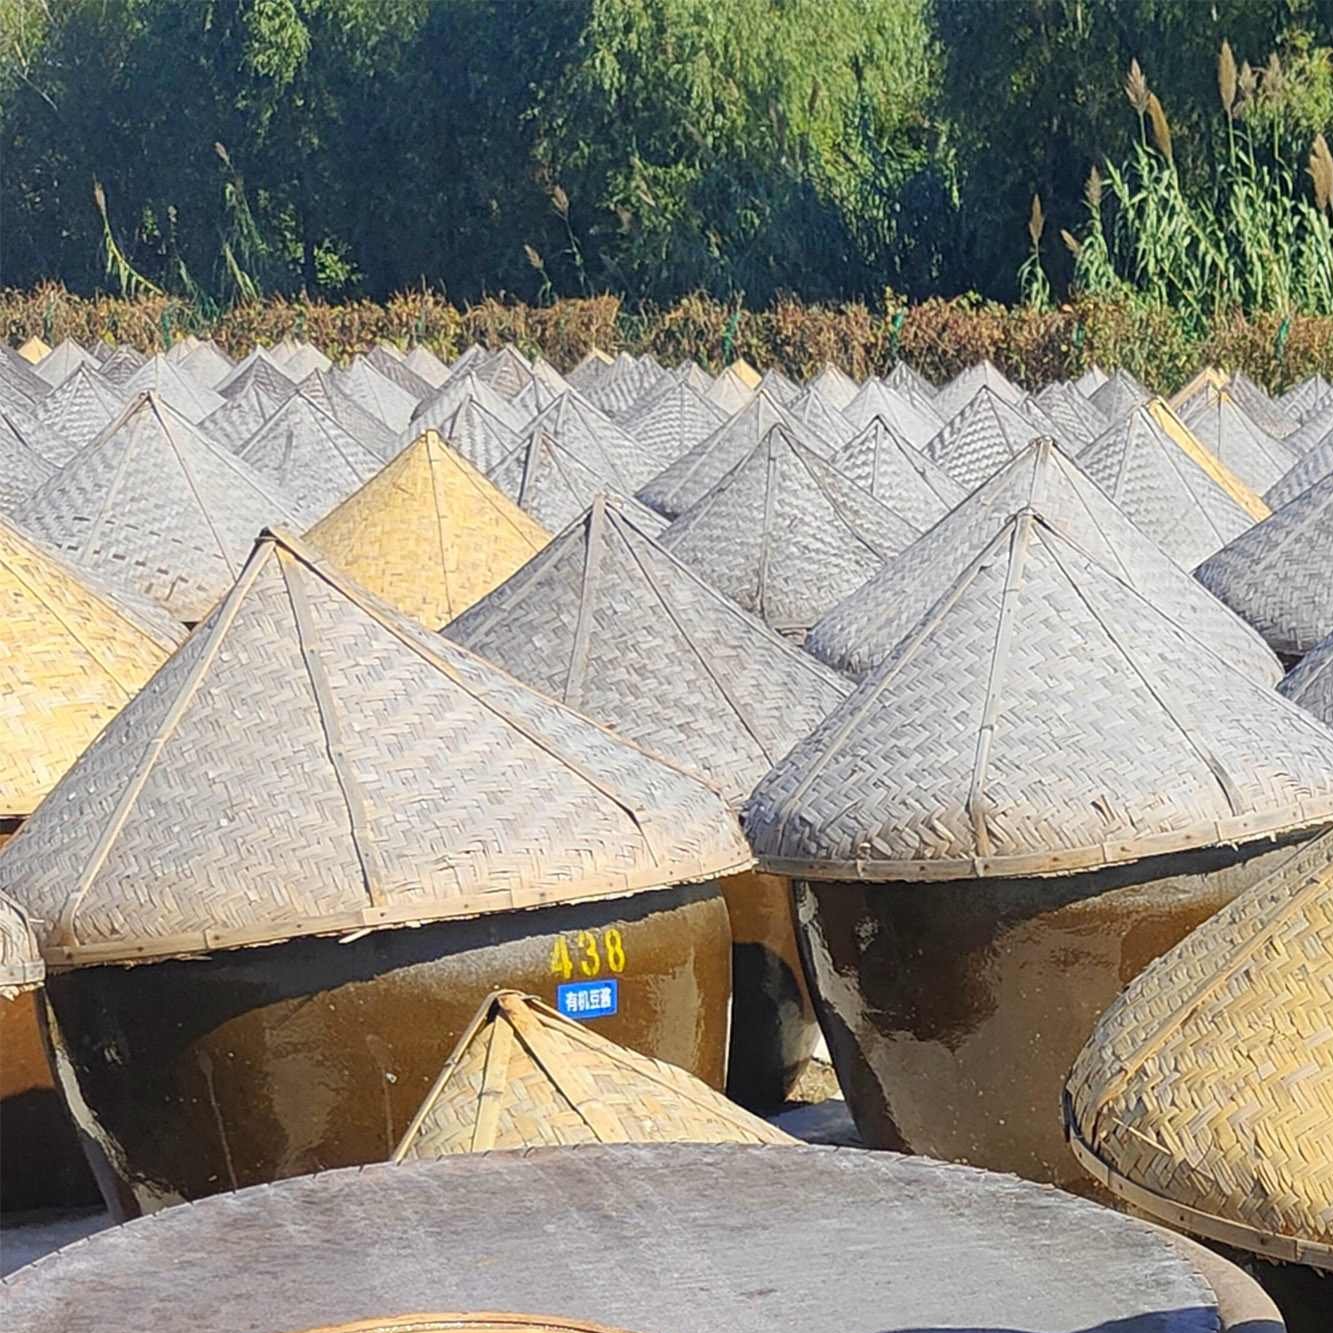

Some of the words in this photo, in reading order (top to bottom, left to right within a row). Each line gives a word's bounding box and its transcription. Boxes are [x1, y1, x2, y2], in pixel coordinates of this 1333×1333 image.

[551, 928, 626, 979] 438
[565, 987, 612, 1013] 有机豆酱
